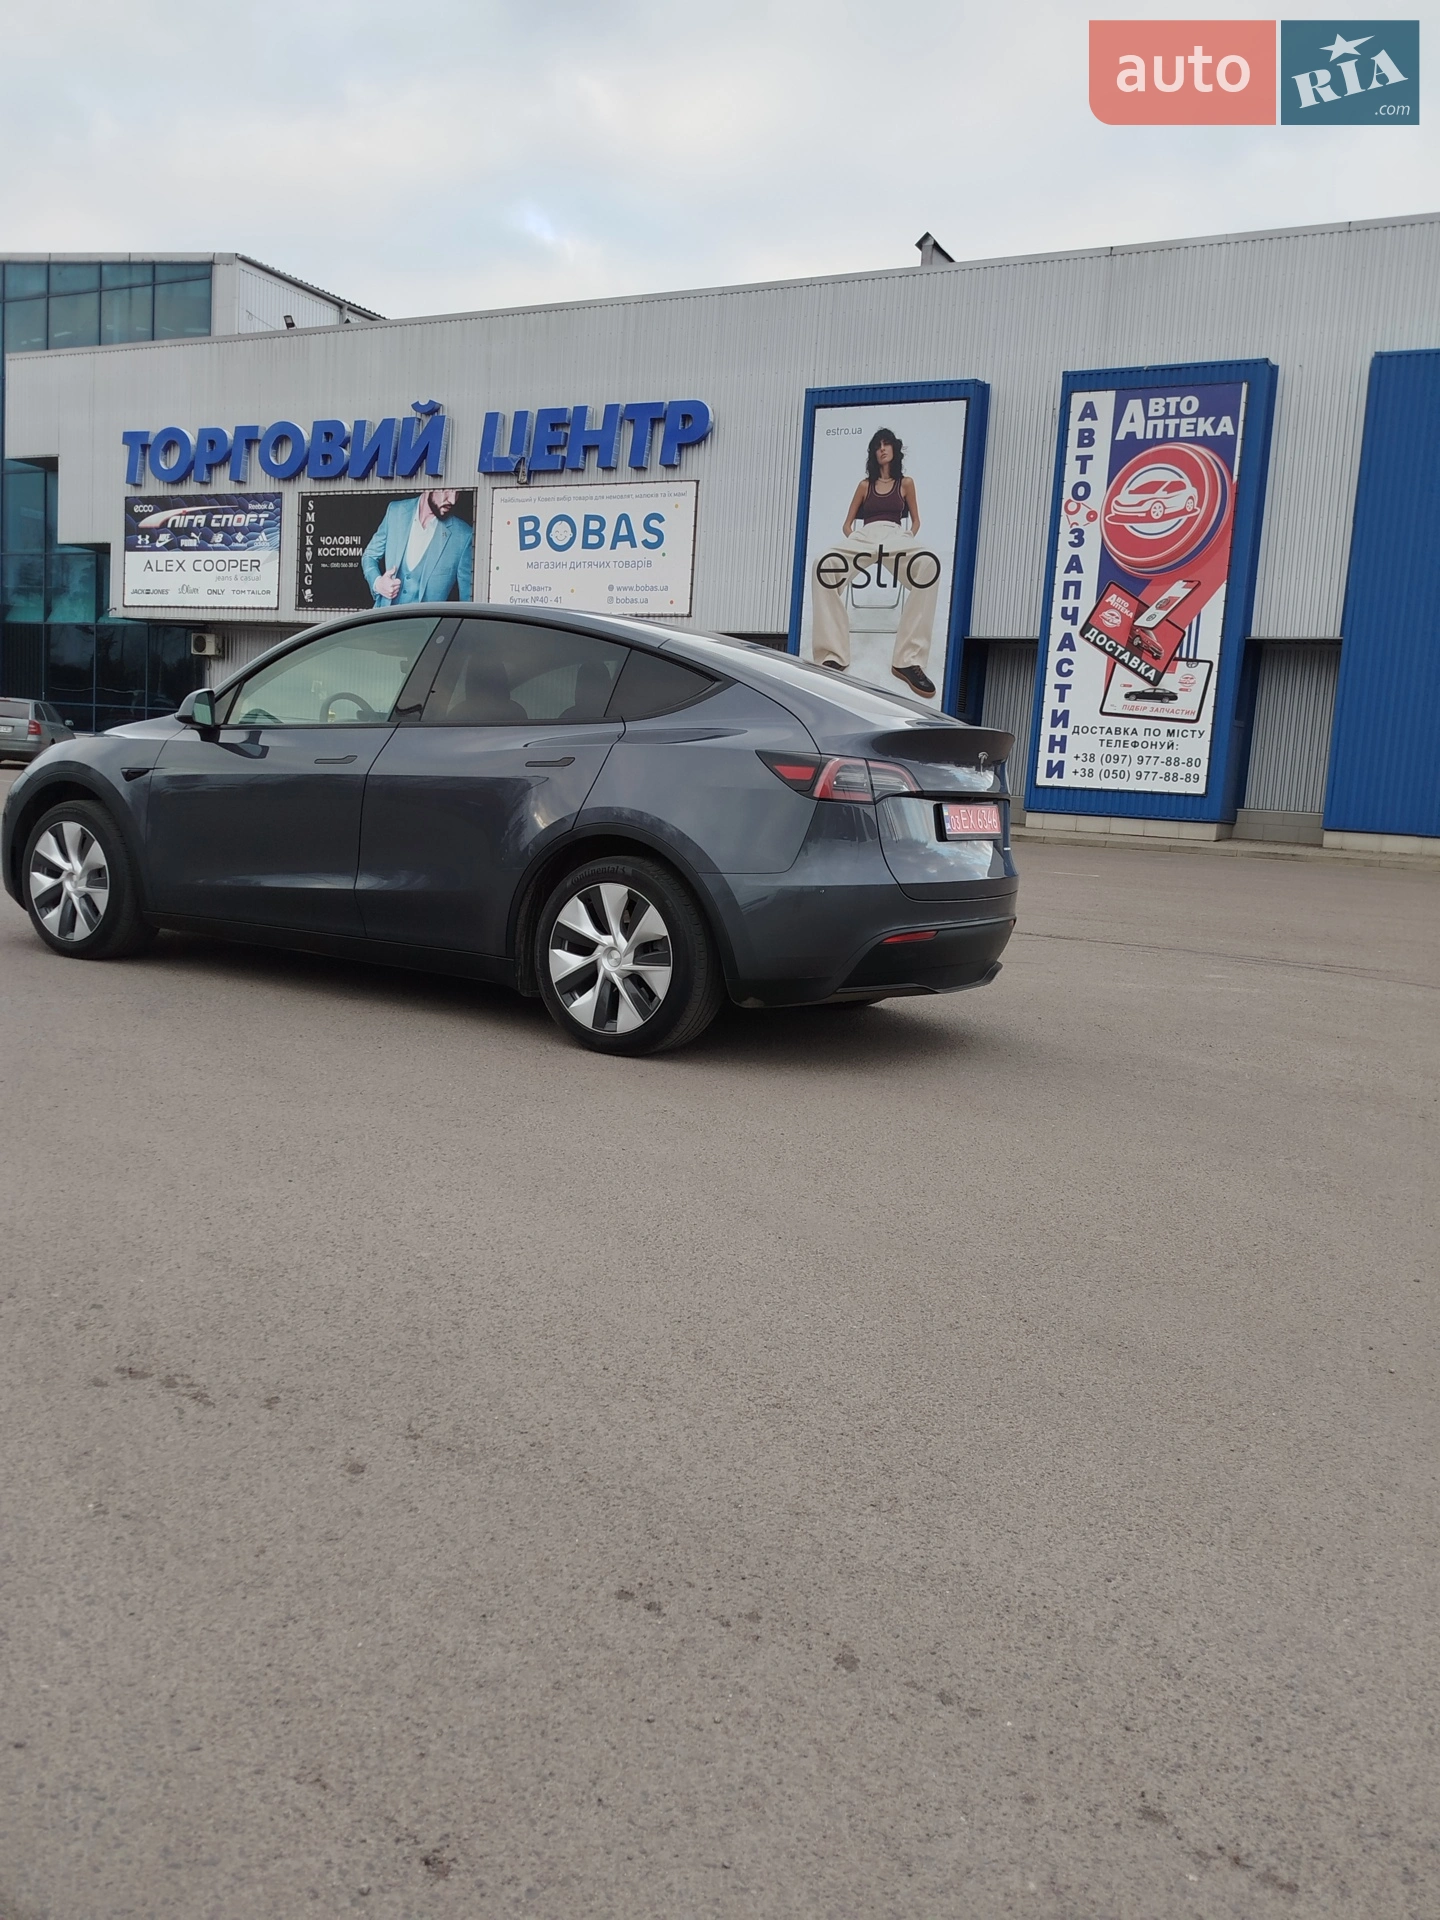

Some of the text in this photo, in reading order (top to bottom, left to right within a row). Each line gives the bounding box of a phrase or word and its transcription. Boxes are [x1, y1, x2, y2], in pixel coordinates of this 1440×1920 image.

[826, 427, 863, 436] estro.ua
[122, 399, 713, 485] ТОРГОВИЙ ЦЕНТР
[572, 494, 594, 502] товарів
[133, 504, 153, 513] ecco
[517, 512, 666, 552] BOBAS
[320, 536, 361, 545] ЧОЛОВІЧІ
[317, 547, 363, 557] КОСТЮМИ
[143, 559, 261, 572] ALEX COOPER
[526, 557, 653, 571] магазин дитячих товарів
[816, 544, 941, 589] estro
[215, 574, 262, 582] jeans & casual
[510, 584, 552, 593] ТЦ «Ювант»
[616, 584, 669, 592] www.bobas.ua
[509, 596, 530, 605] бутик
[530, 596, 548, 604] №40
[554, 596, 562, 604] 41
[615, 596, 649, 604] bobas.ua
[1084, 627, 1156, 682] ДОСТАВКА
[1122, 704, 1148, 712] ПІДБІР
[1149, 706, 1196, 716] ЗАПЧАСТИН
[1072, 725, 1206, 739] ДОСТАВКА ПО МІСТУ
[1098, 739, 1179, 750] ТЕЛЕФОНУЙ:
[1073, 753, 1201, 768] +38 (097) 977-88-80
[1072, 768, 1200, 784] +38 (050) 977-88-89
